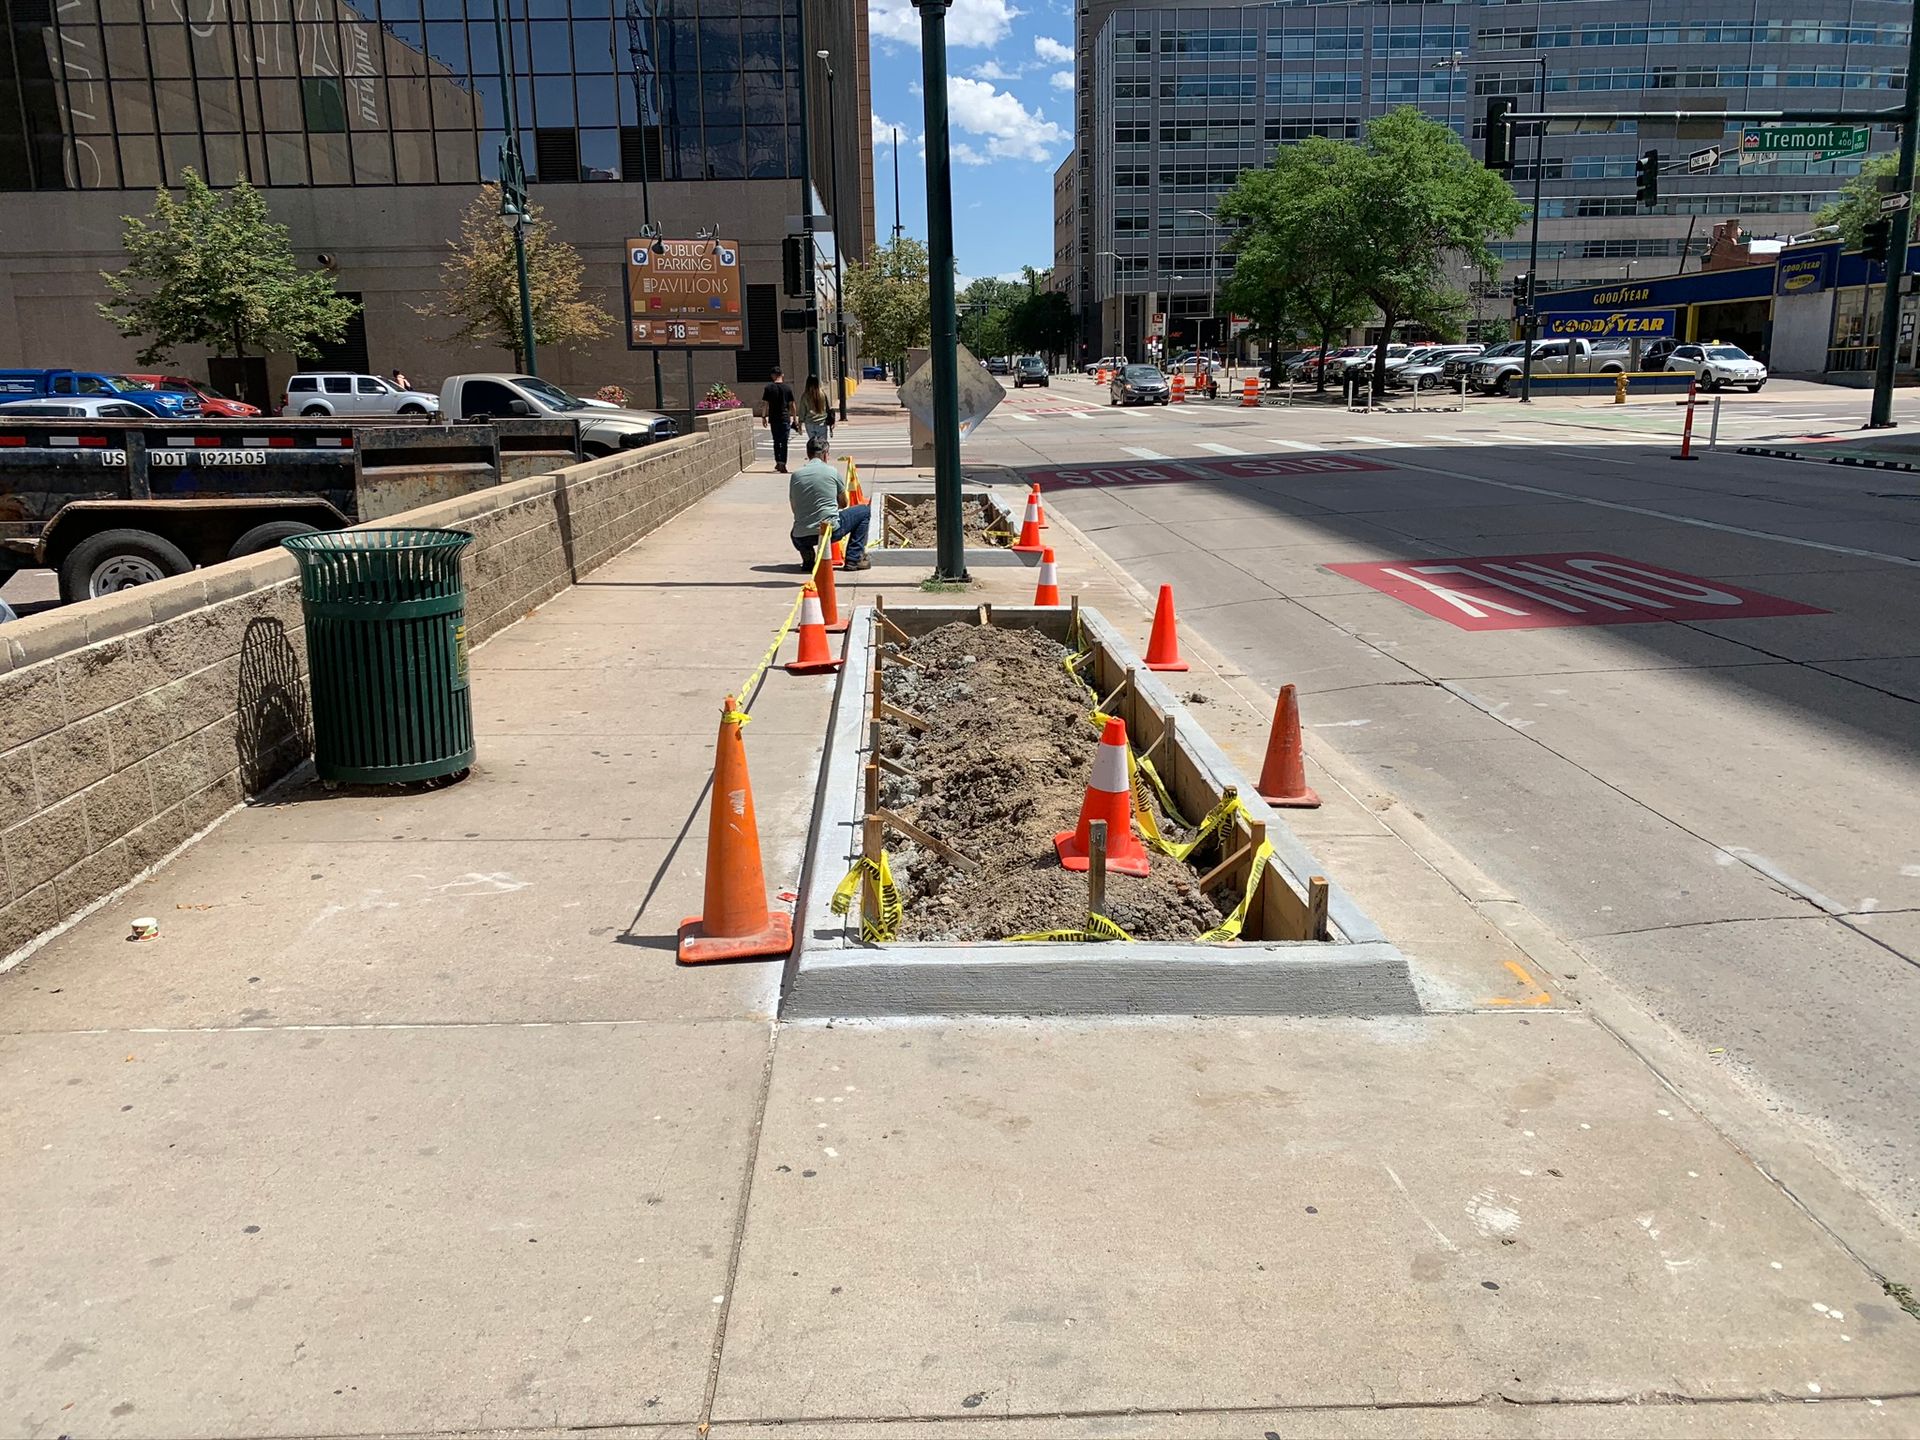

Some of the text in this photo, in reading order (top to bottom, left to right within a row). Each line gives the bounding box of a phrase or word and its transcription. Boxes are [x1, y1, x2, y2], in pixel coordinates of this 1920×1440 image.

[1764, 131, 1834, 147] Tremont
[1692, 155, 1710, 167] ONE WAY
[663, 244, 705, 257] PUBLIC
[657, 258, 712, 271] PARKING
[1782, 260, 1821, 272] GOODYEAR
[651, 278, 729, 294] PAVILIONS
[1593, 287, 1649, 305] GOODYEAR
[634, 325, 647, 338] $5
[668, 324, 686, 339] $18
[1552, 313, 1665, 336] GOODYEAR
[103, 452, 264, 465] US DOT 1921505
[1231, 458, 1362, 475] BUS
[1055, 466, 1171, 485] BUS
[1380, 558, 1744, 618] ONLY
